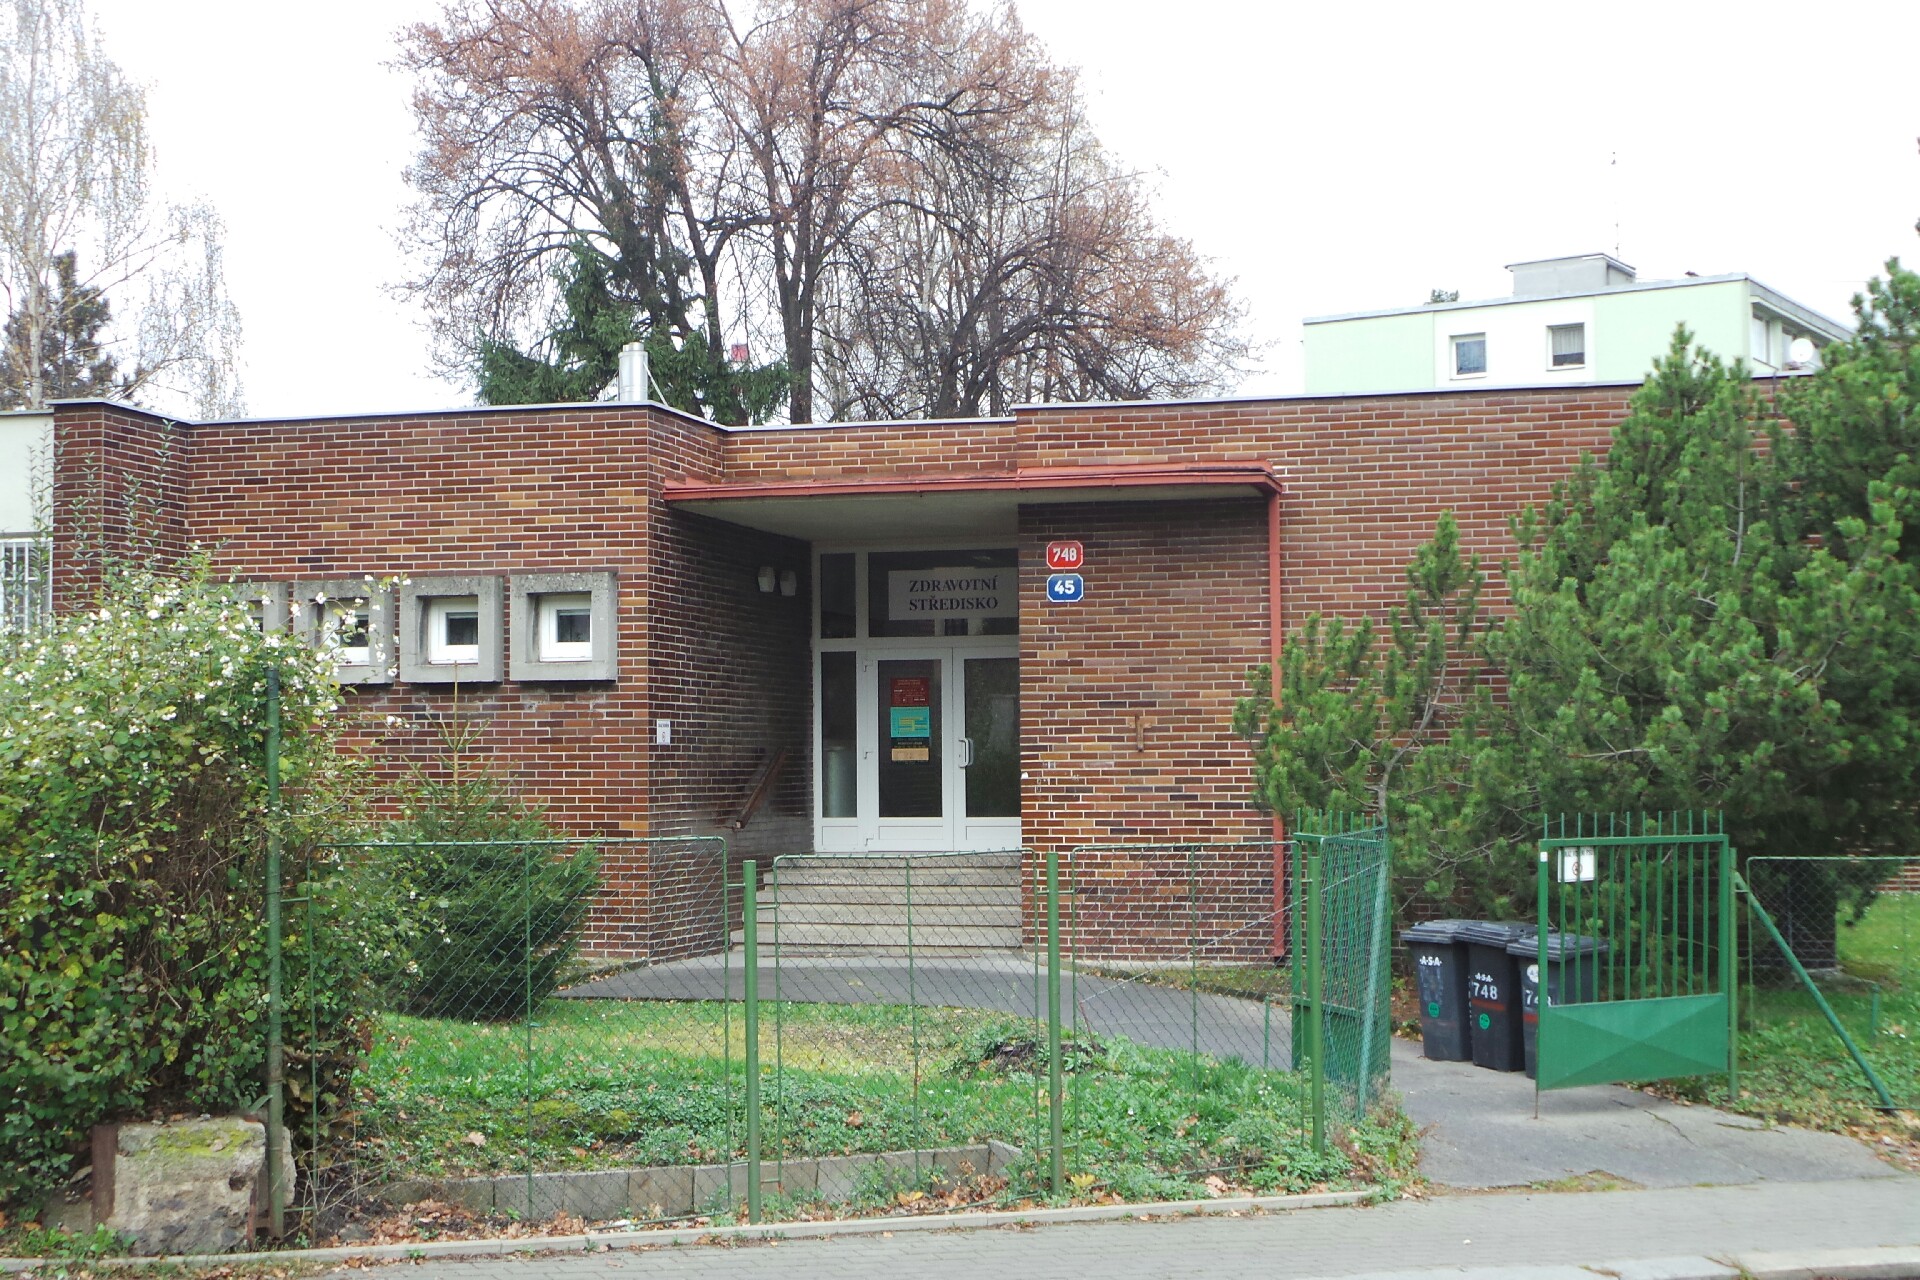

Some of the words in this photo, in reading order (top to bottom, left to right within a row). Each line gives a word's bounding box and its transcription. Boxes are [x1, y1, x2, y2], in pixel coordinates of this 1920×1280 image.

[1052, 547, 1077, 562] 748
[909, 575, 998, 593] ZDRAVOTNÍ
[1054, 579, 1075, 595] 45
[909, 595, 998, 611] STŘEDISKO
[1473, 982, 1498, 1000] 748
